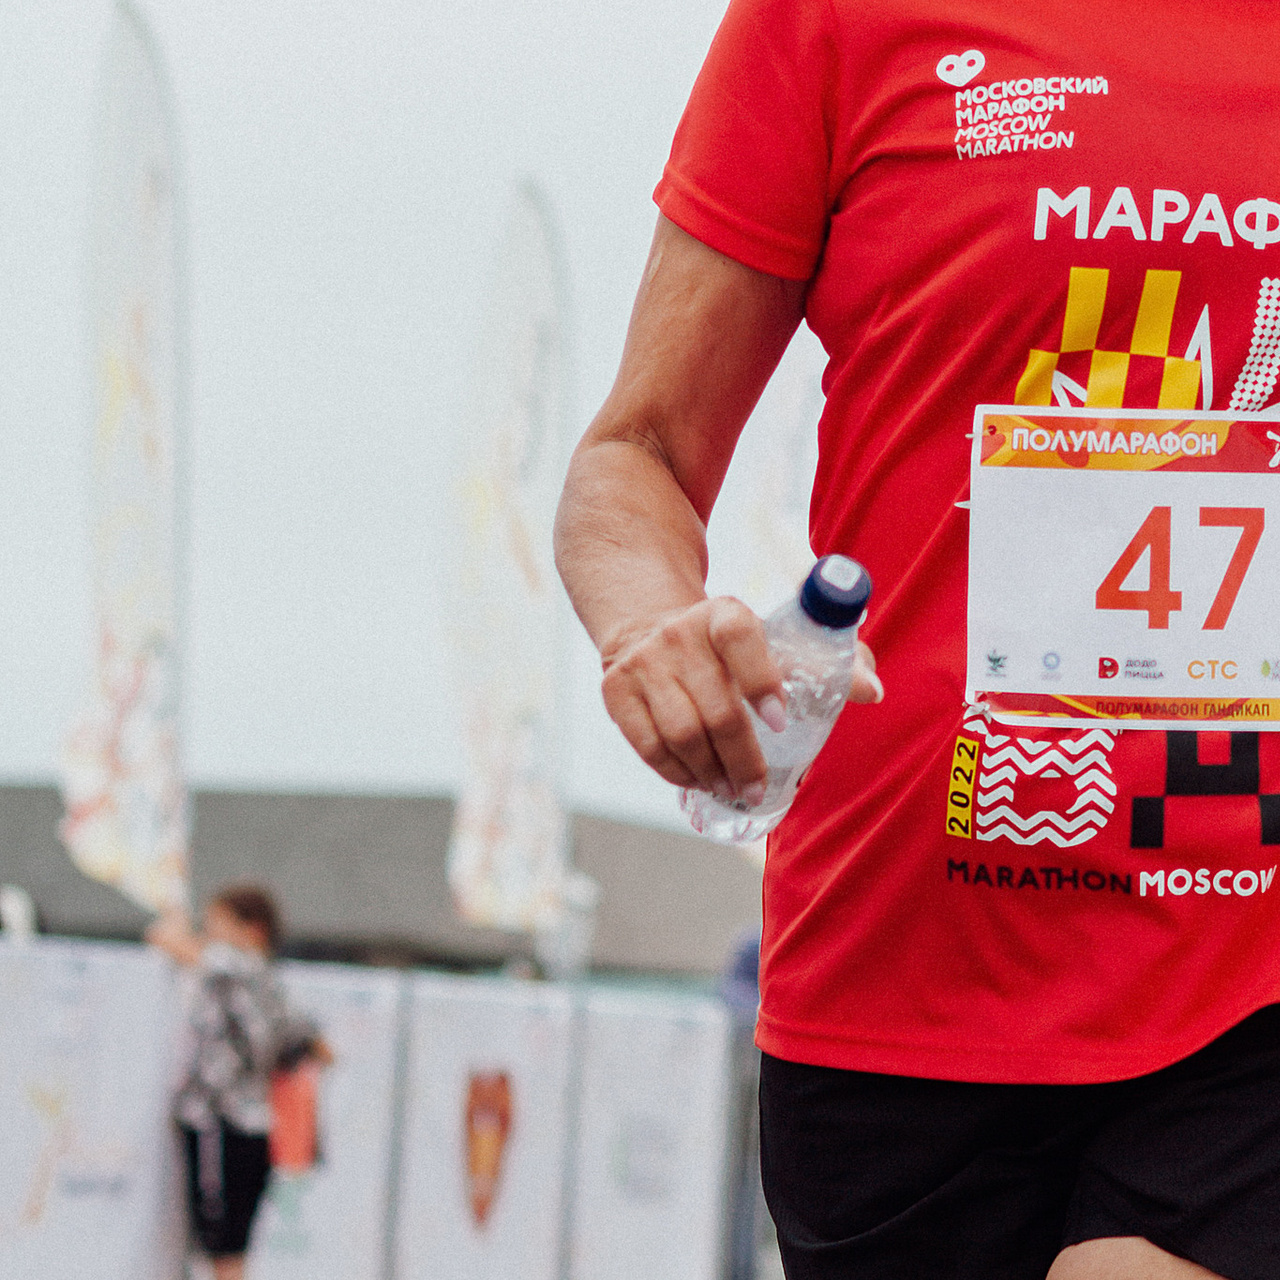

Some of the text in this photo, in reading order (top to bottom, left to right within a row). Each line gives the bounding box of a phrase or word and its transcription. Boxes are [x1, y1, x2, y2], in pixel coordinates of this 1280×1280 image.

[955, 75, 1109, 109] МОСКОВСКИЙ
[955, 94, 1066, 127] МАРАФОН
[954, 113, 1052, 143] MOSCOW
[956, 131, 1075, 160] MARATHON
[1011, 427, 1218, 457] ПОЛУМАРАФОН
[1095, 505, 1266, 631] 47
[1187, 659, 1239, 680] СТС
[1096, 701, 1270, 718] ПОЛУМАРАФОН ГАНДИКАП
[947, 741, 977, 836] 2022
[946, 858, 1277, 897] MARATHON MOSCOW
